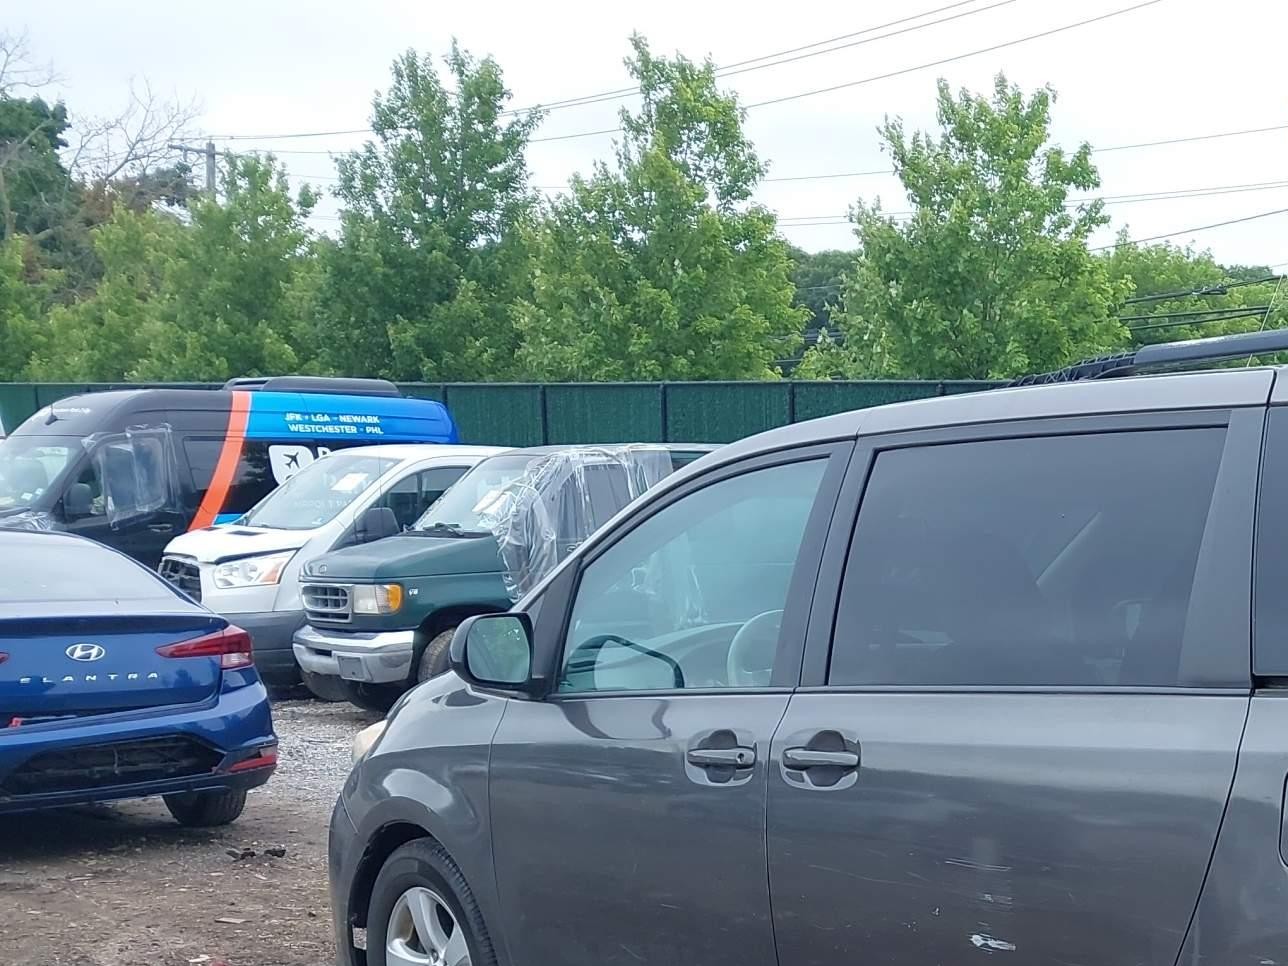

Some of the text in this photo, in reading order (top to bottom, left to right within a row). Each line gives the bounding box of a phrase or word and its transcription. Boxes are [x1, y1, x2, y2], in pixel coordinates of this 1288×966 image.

[285, 412, 380, 424] JFK LGA NEWARK
[288, 423, 384, 435] WESTCHESTER PHL
[19, 672, 158, 684] ELANTRA
